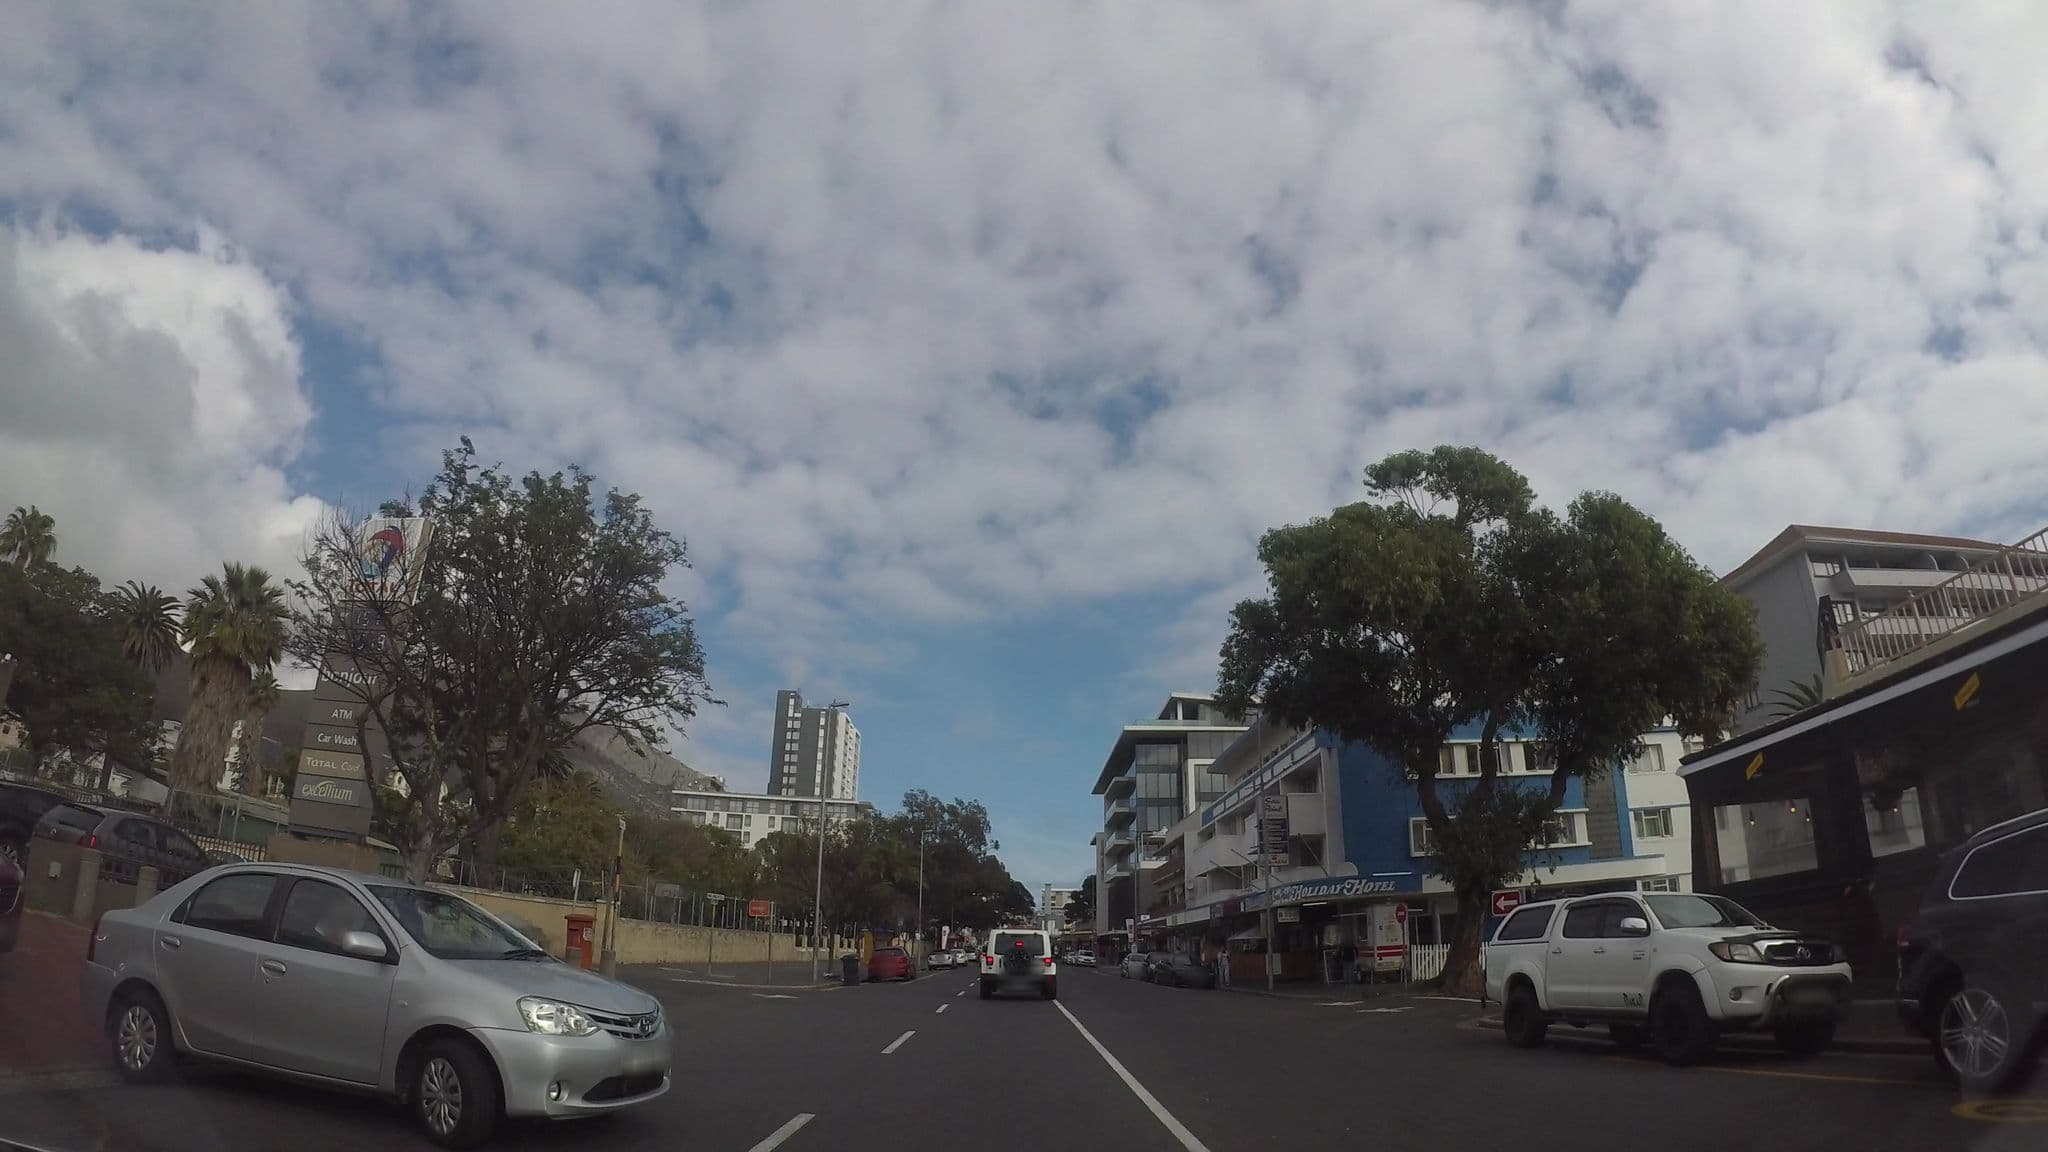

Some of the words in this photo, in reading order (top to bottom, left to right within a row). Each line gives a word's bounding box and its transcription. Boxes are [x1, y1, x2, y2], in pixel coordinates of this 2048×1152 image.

[321, 666, 377, 688] bonjour
[331, 708, 353, 720] ATM
[317, 732, 332, 743] Car
[334, 734, 357, 746] Wash
[305, 756, 338, 769] TOTAL
[302, 780, 353, 801] excellium
[1289, 883, 1344, 901] HOLIDAY
[1343, 879, 1396, 896] HOTEL
